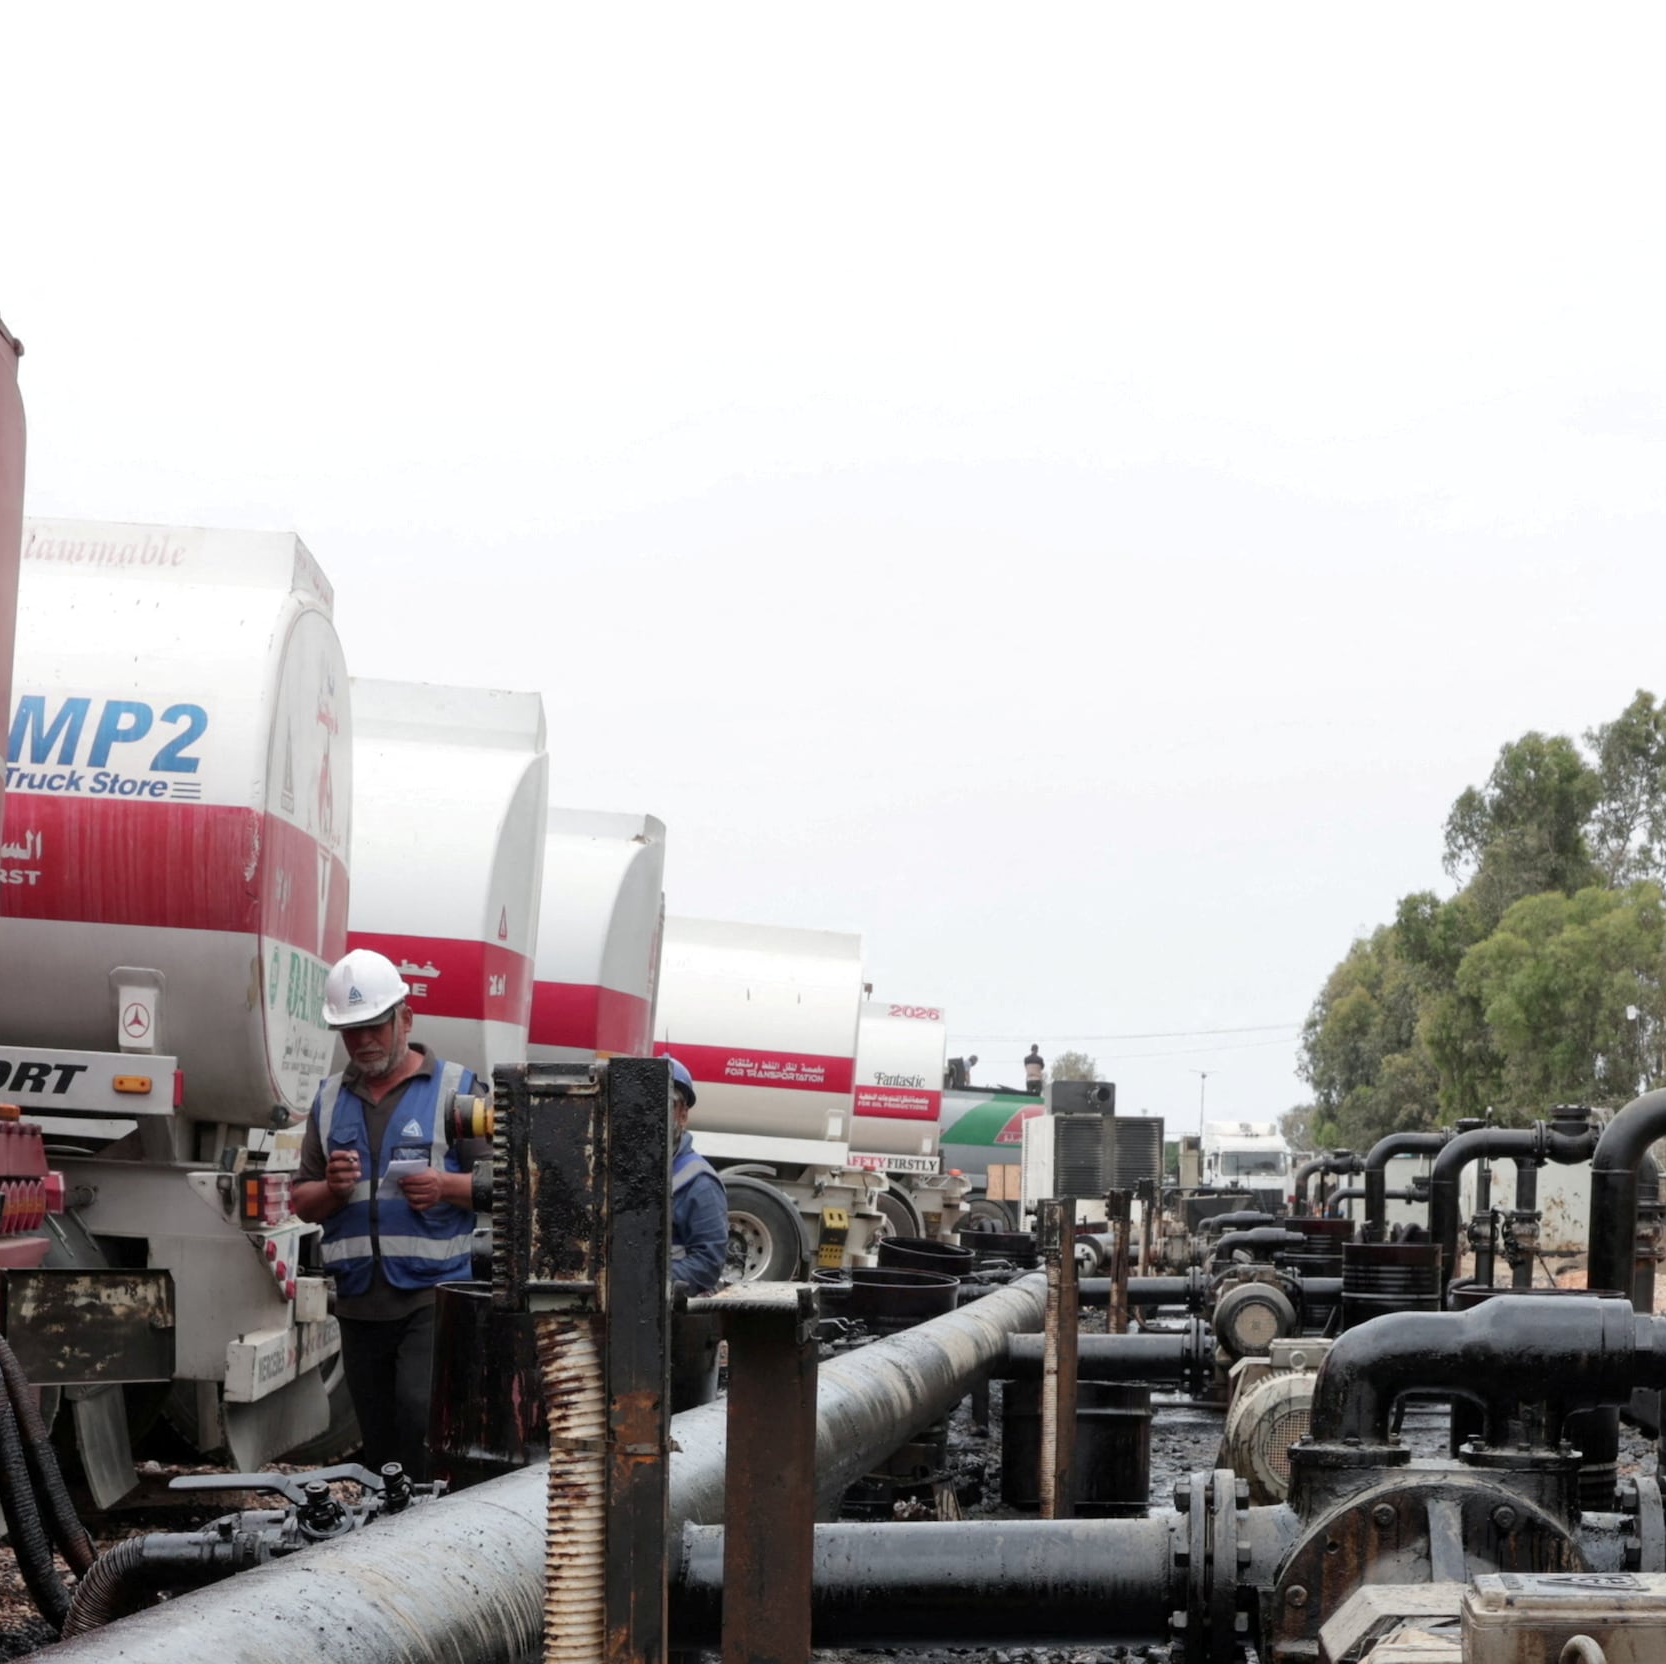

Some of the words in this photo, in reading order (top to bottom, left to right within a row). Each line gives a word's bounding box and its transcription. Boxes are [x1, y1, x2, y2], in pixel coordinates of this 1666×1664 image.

[23, 529, 186, 567] lammable
[7, 695, 209, 774] MP2
[5, 767, 85, 792] Truck
[89, 771, 169, 798] Store
[888, 1003, 940, 1021] 2026
[874, 1071, 926, 1089] Fantastic
[848, 1155, 886, 1169] AFETY
[887, 1158, 938, 1172] FIRSTLY
